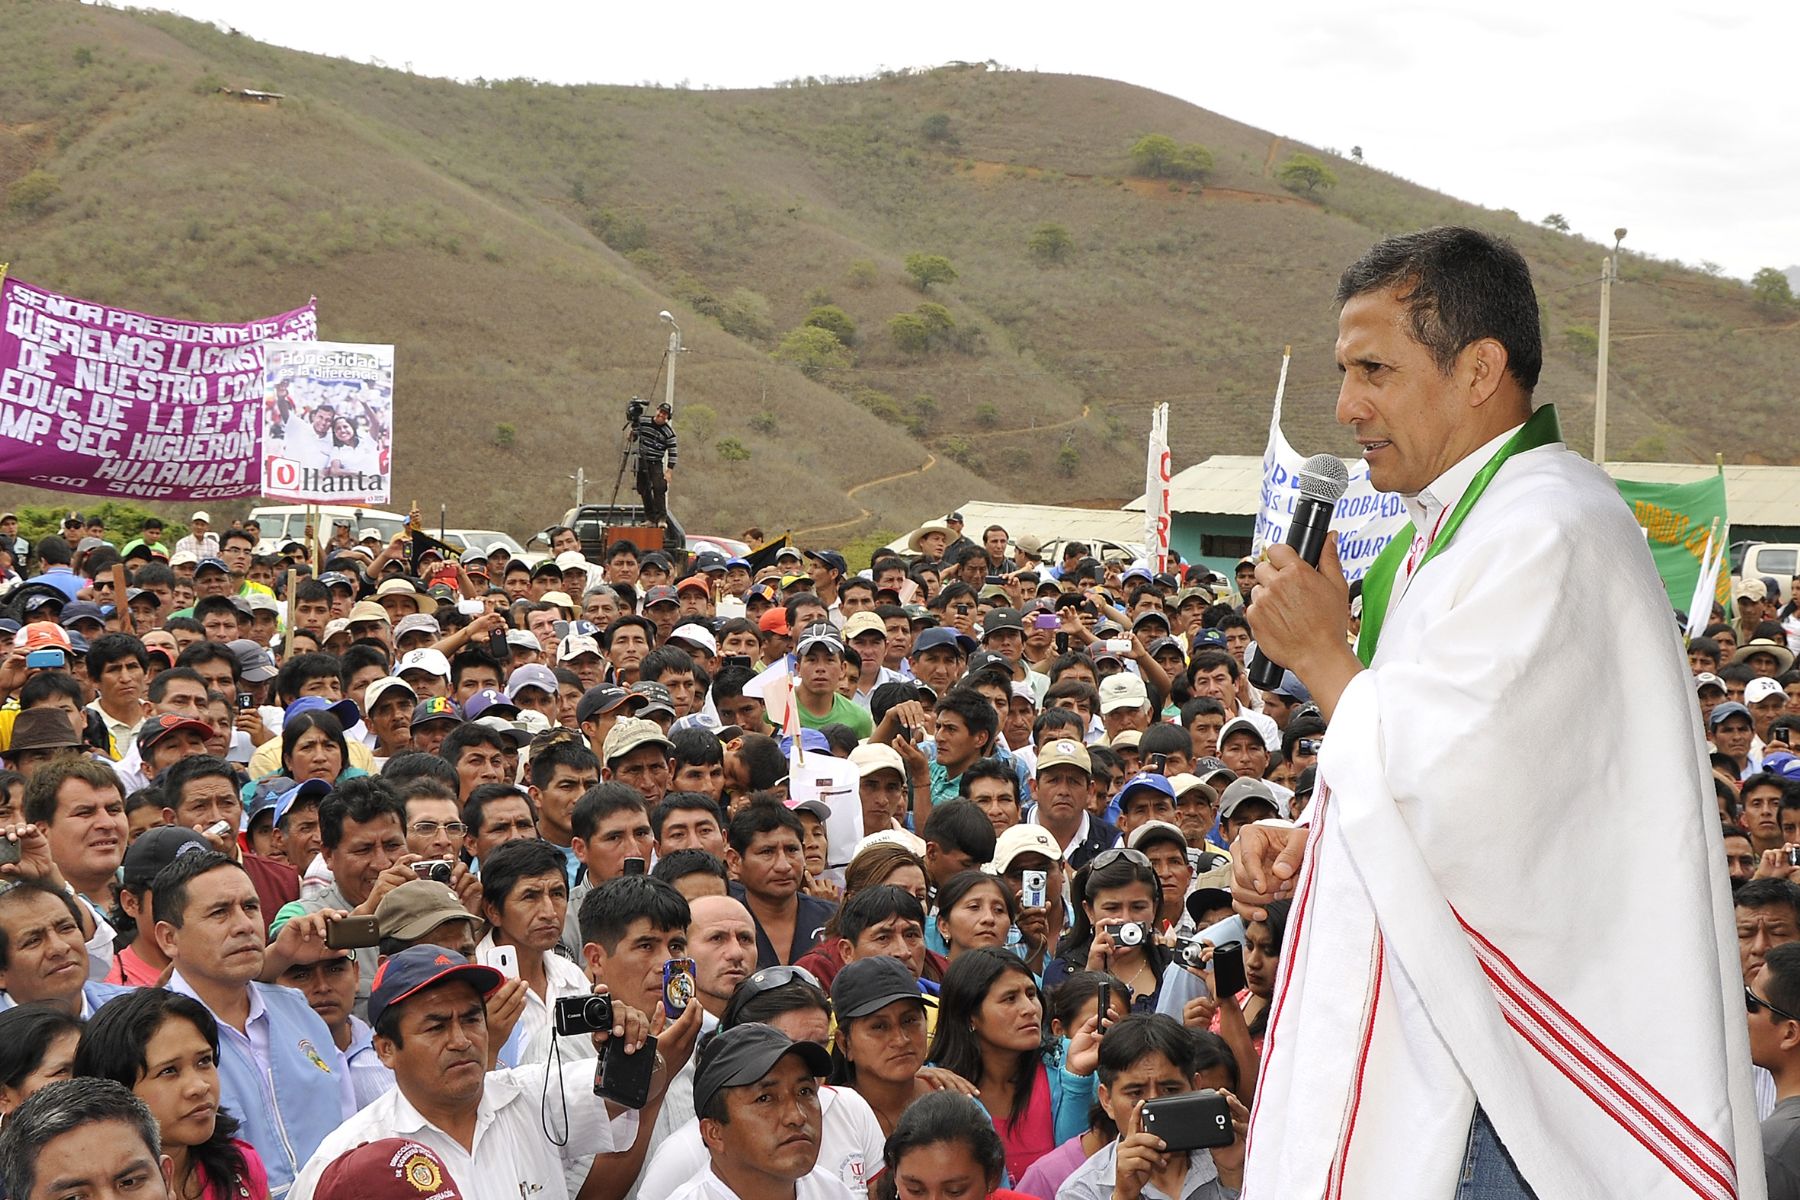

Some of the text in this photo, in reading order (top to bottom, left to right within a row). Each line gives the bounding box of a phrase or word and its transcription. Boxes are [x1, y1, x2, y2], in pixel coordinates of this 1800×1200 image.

[5, 301, 166, 371] QUEREMOS
[106, 310, 250, 344] PRESIDENTE
[18, 340, 60, 380] DE
[74, 358, 208, 405] NUESTRO
[280, 367, 379, 381] es la diferencia
[281, 353, 379, 370] Honestidad
[88, 393, 134, 431] DE
[146, 402, 184, 434] LA
[192, 403, 234, 434] IEP
[57, 419, 121, 459] SEC.
[106, 481, 173, 497] SNIP
